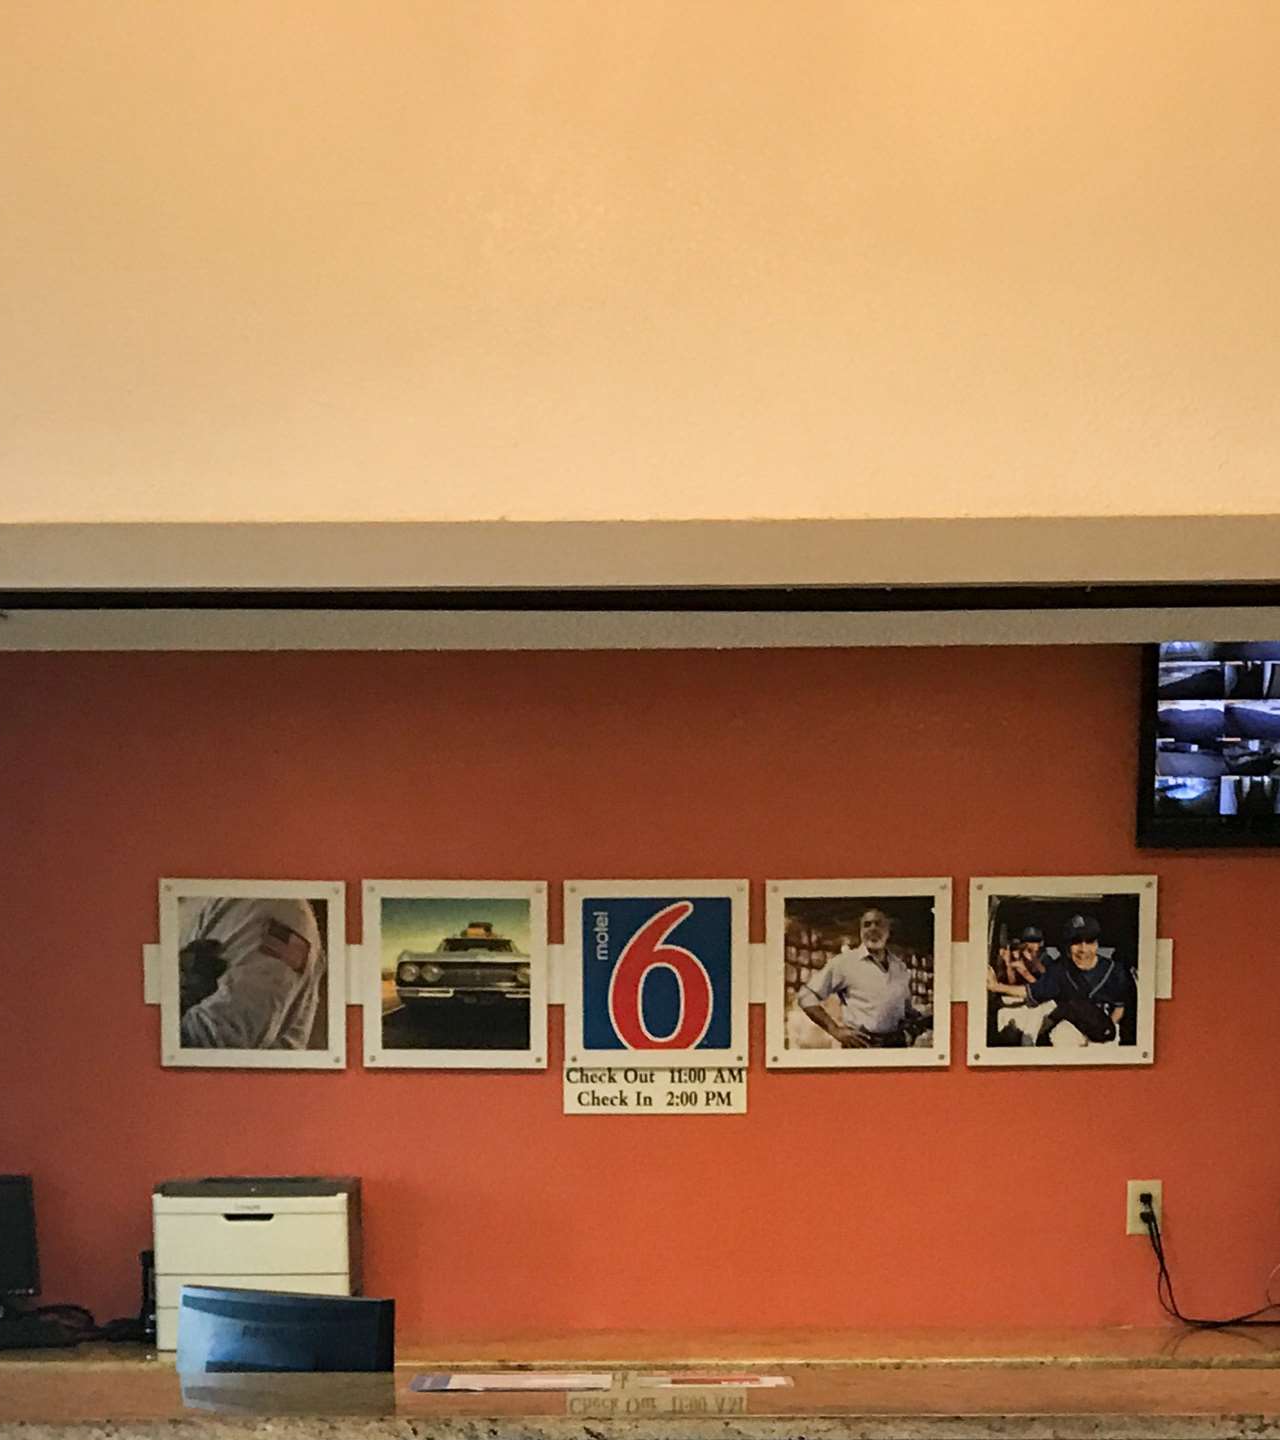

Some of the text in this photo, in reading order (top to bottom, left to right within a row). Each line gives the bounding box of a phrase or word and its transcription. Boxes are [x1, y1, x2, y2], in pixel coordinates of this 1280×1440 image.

[593, 911, 608, 960] motel
[608, 900, 713, 1050] 6
[566, 1067, 744, 1084] Check Out 11:00 AM
[577, 1090, 732, 1107] Check In 2:00 PM
